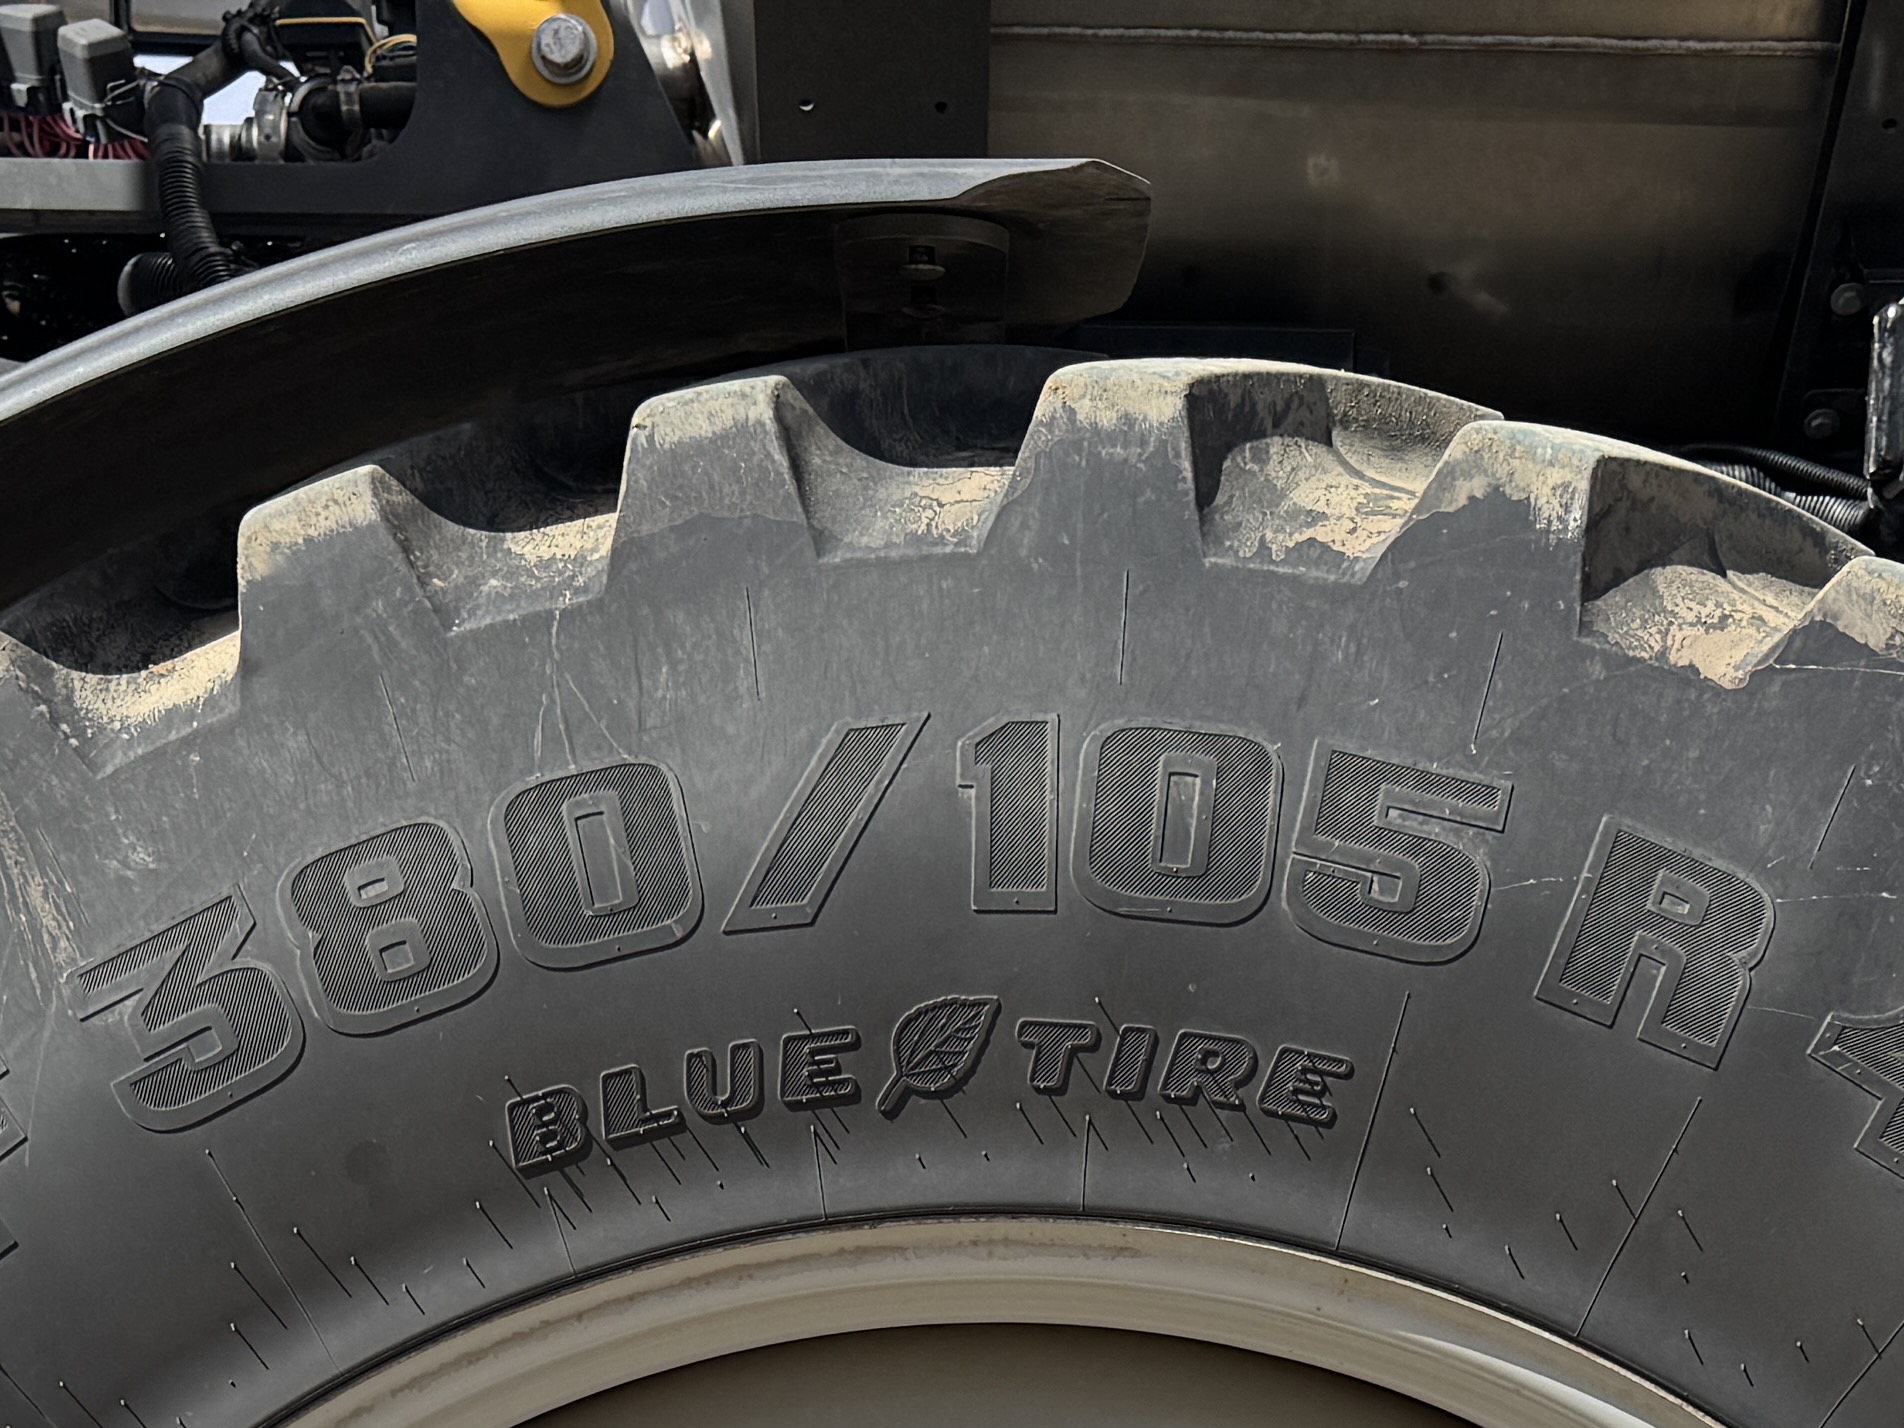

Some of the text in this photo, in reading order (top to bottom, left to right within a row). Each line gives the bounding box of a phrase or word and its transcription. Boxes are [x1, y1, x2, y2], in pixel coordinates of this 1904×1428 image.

[1536, 816, 1779, 1070] R
[504, 1017, 1355, 1177] BLUE TIRE
